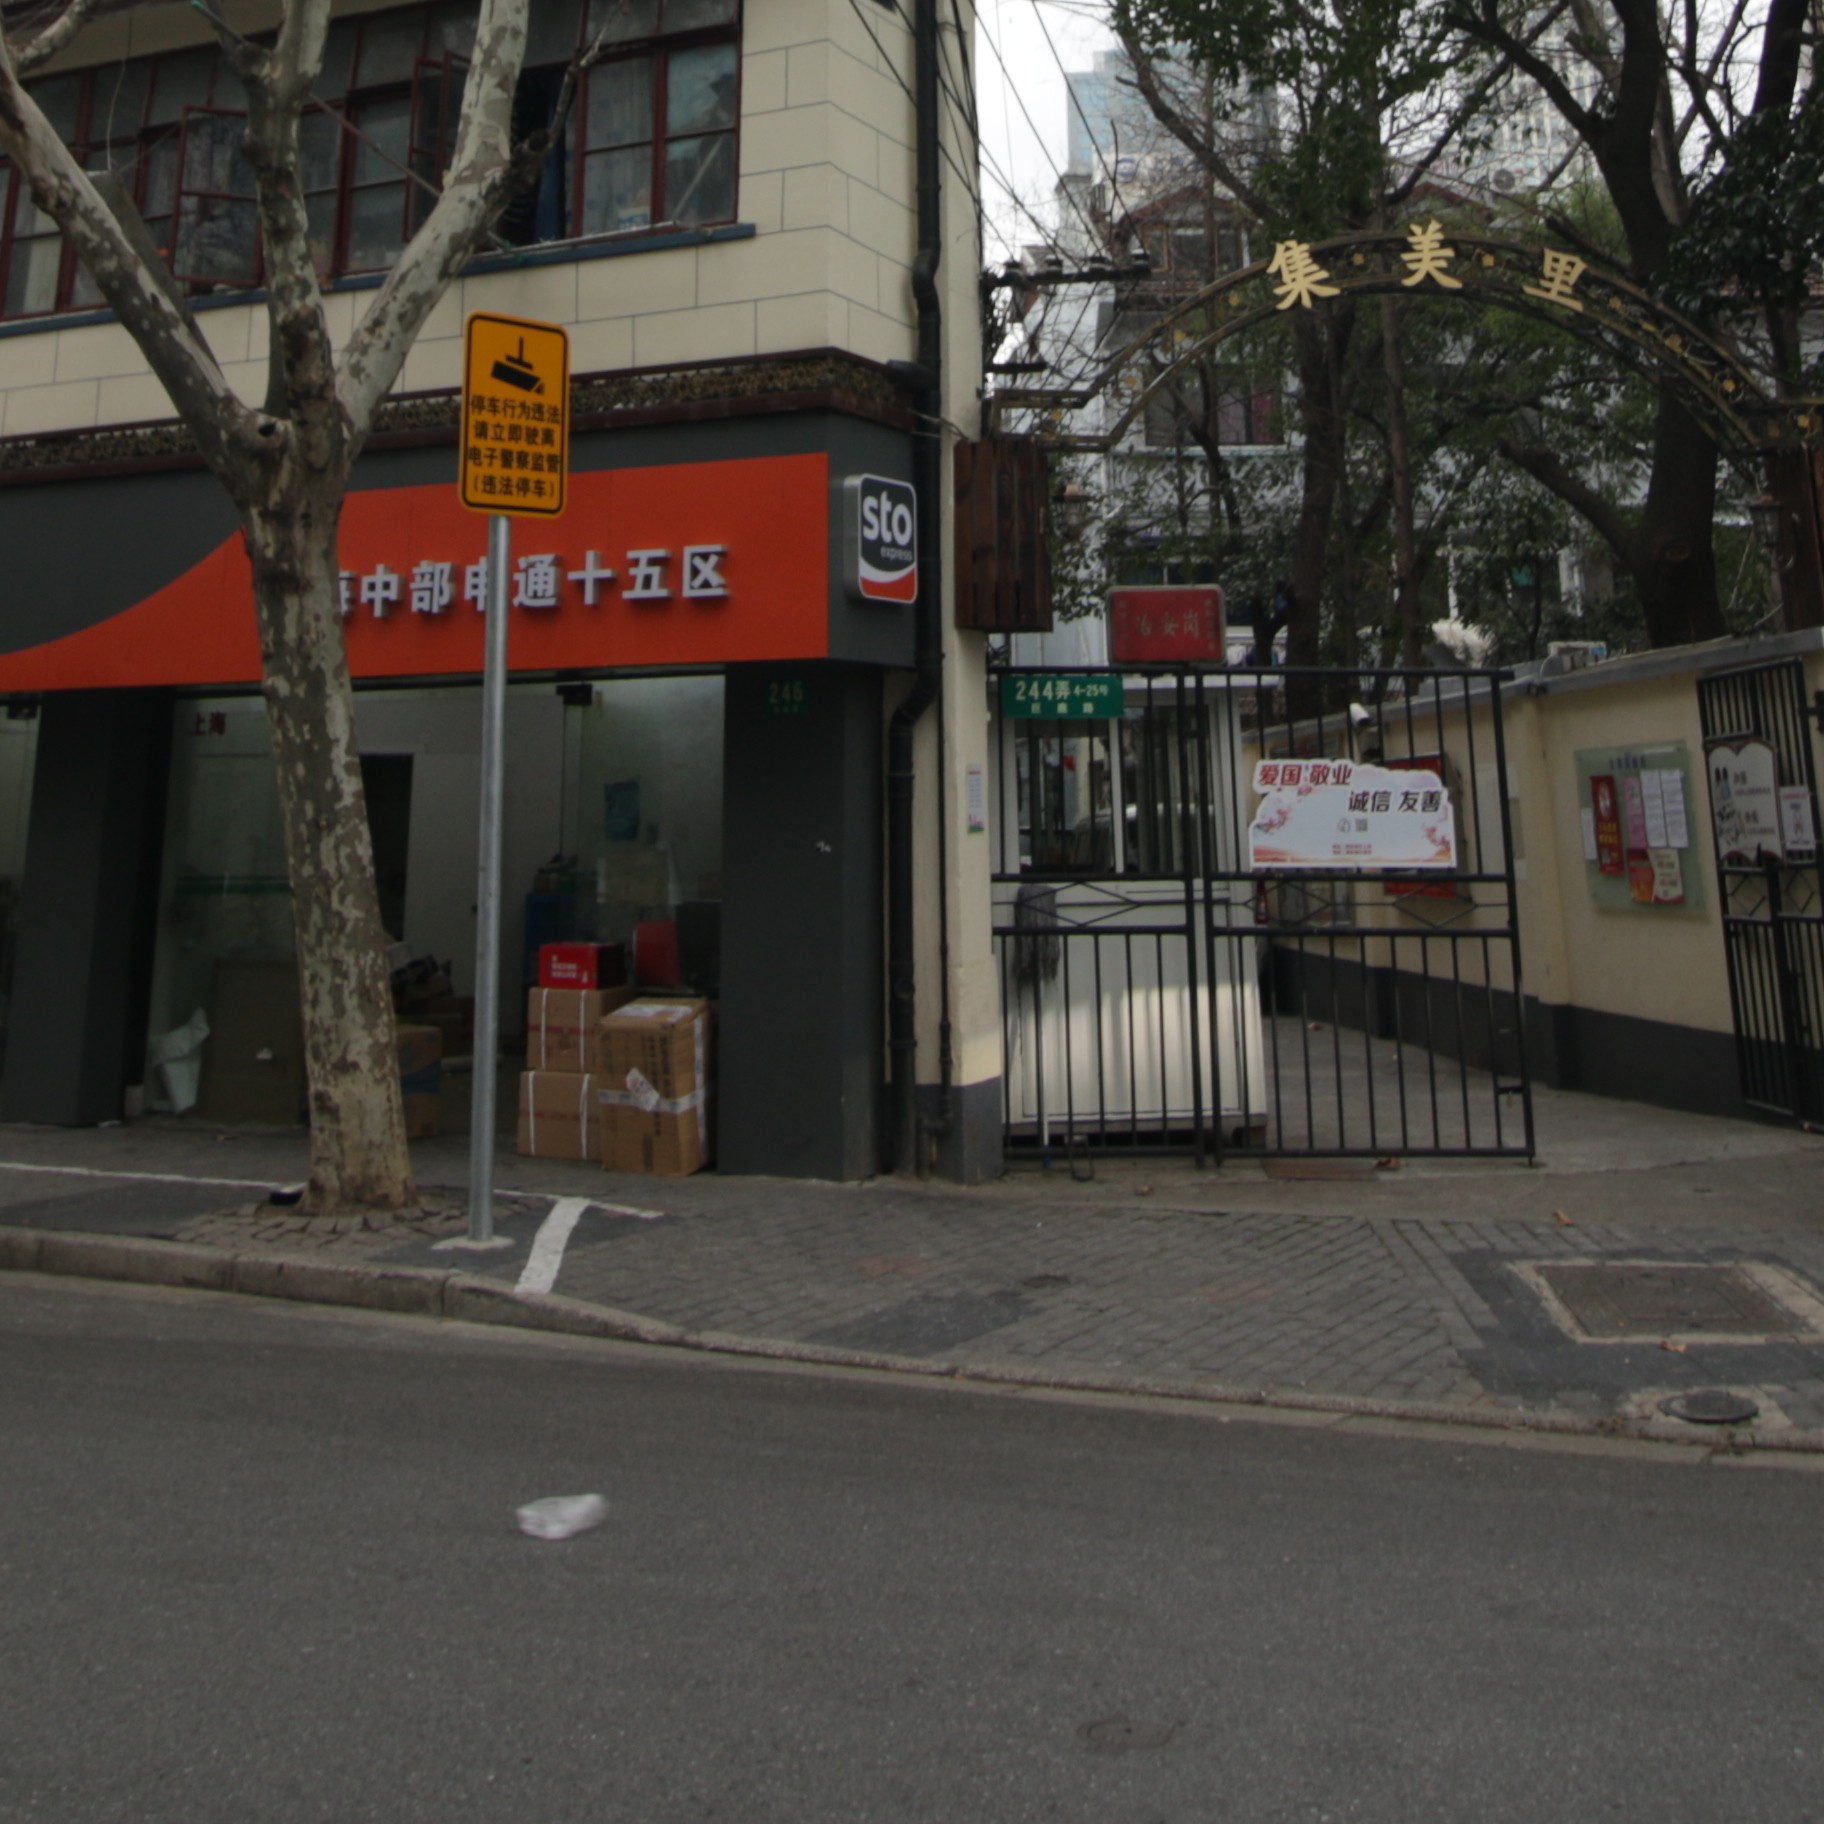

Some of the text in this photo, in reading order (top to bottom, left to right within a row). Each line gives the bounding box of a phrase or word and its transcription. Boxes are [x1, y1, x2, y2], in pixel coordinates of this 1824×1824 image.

[1266, 219, 1588, 313] 集美里
[471, 395, 561, 424] 停车行为违法
[474, 421, 555, 447] 请立即驶离
[468, 446, 561, 473] 电子警察监管
[862, 490, 913, 547] sto
[880, 546, 913, 563] express
[769, 680, 804, 704] 246
[1258, 764, 1353, 786] 爱国 敬业
[1348, 790, 1443, 813] 诚信 友善
